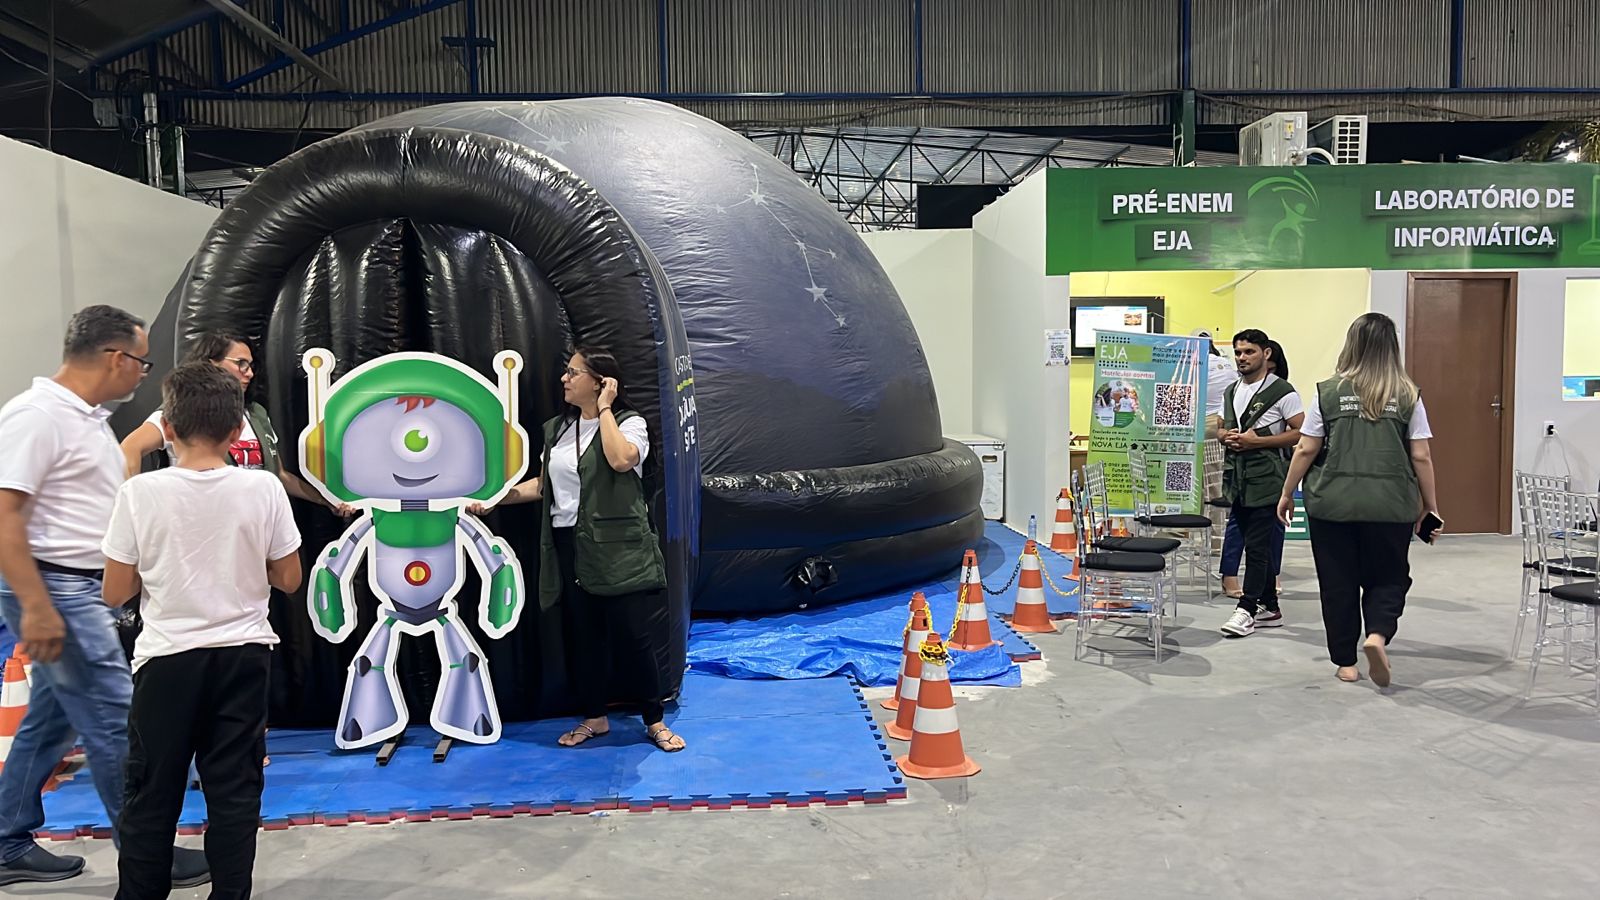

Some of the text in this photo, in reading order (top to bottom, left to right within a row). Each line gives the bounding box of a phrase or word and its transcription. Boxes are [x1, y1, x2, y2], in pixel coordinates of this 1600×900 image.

[1112, 188, 1233, 214] PRÉ-ENEM
[1375, 184, 1575, 210] LABORATÓRIO DE
[1153, 230, 1193, 251] EJA
[1394, 222, 1554, 248] INFORMÁTICA
[1100, 344, 1128, 360] EJA
[1091, 441, 1113, 449] NOVA
